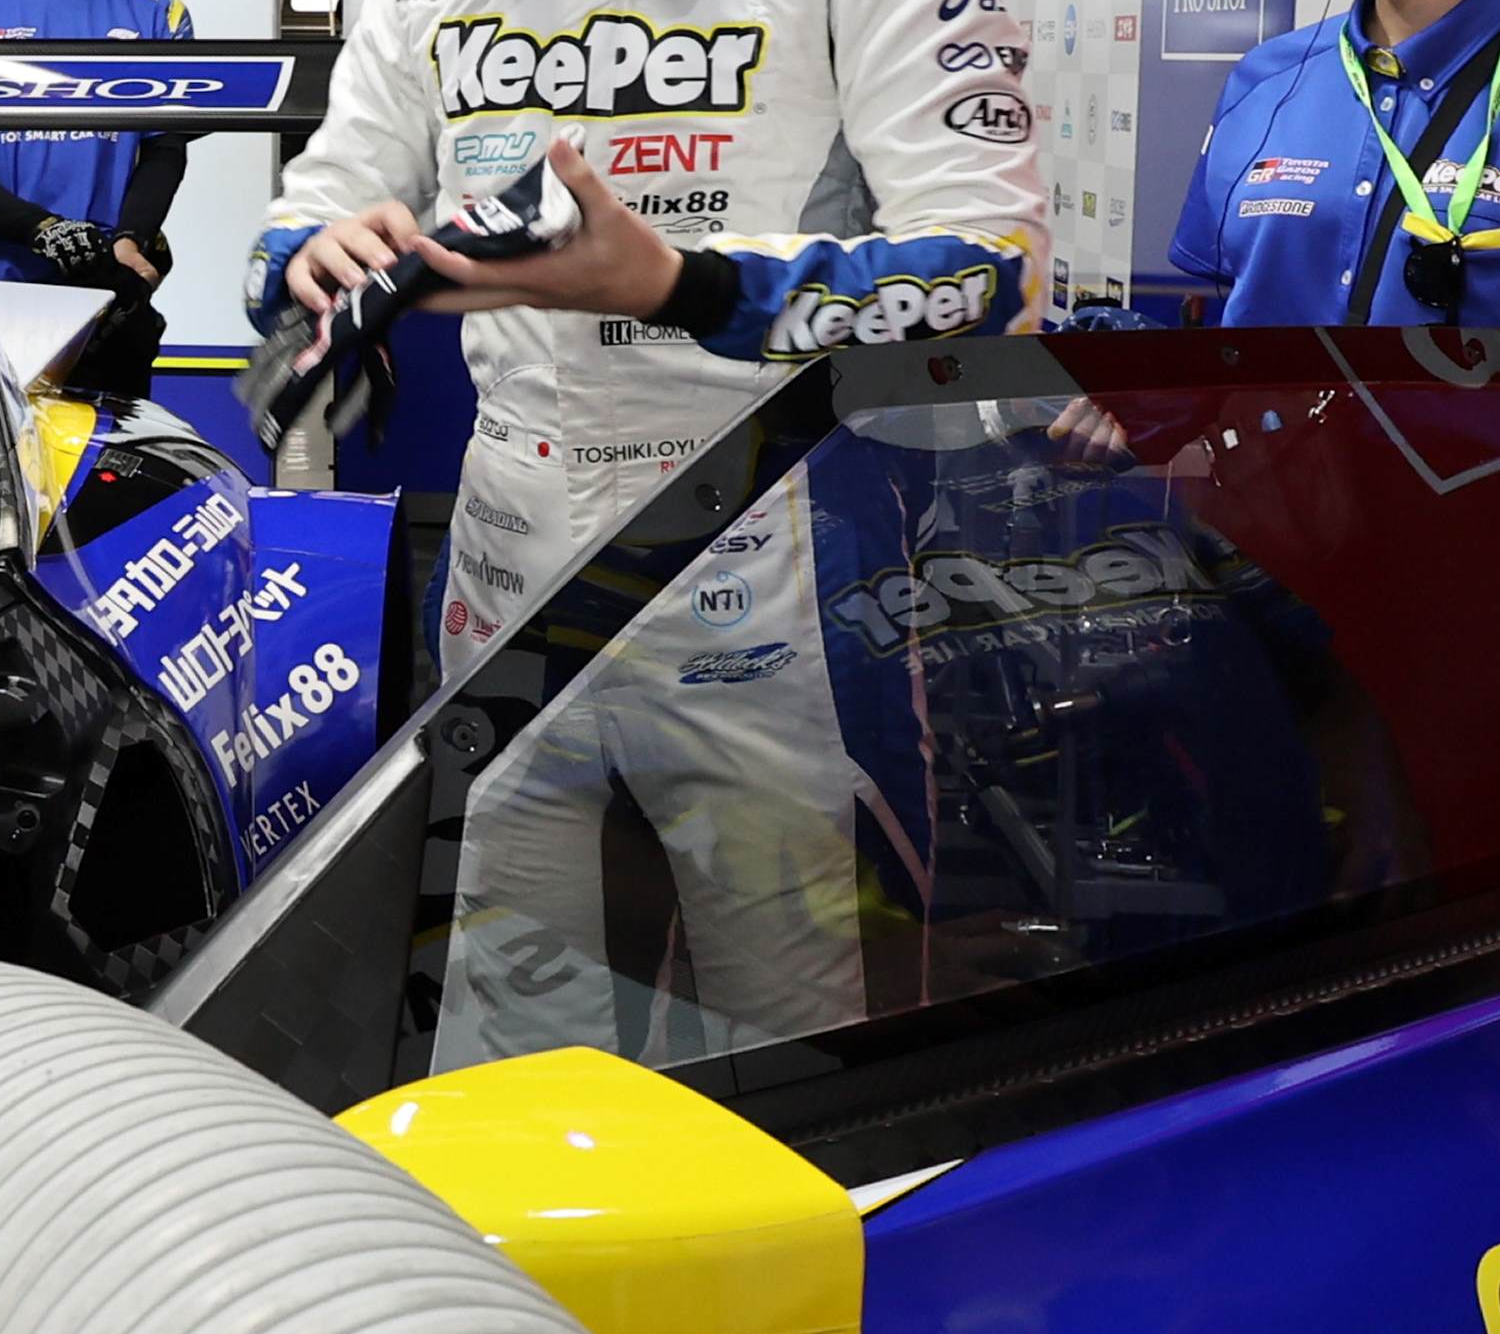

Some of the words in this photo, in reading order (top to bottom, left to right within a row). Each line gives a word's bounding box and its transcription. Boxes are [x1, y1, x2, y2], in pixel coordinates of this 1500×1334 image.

[432, 15, 762, 113] KeePer
[608, 134, 735, 176] ZENT
[1280, 157, 1330, 169] TOYOTA
[1246, 167, 1275, 184] GR
[618, 189, 730, 216] elix88
[1240, 200, 1314, 216] BRIDGESTONE
[764, 272, 989, 354] KeePer
[632, 322, 695, 342] HOME
[211, 641, 362, 791] Felix88
[240, 779, 322, 865] VERTEX
